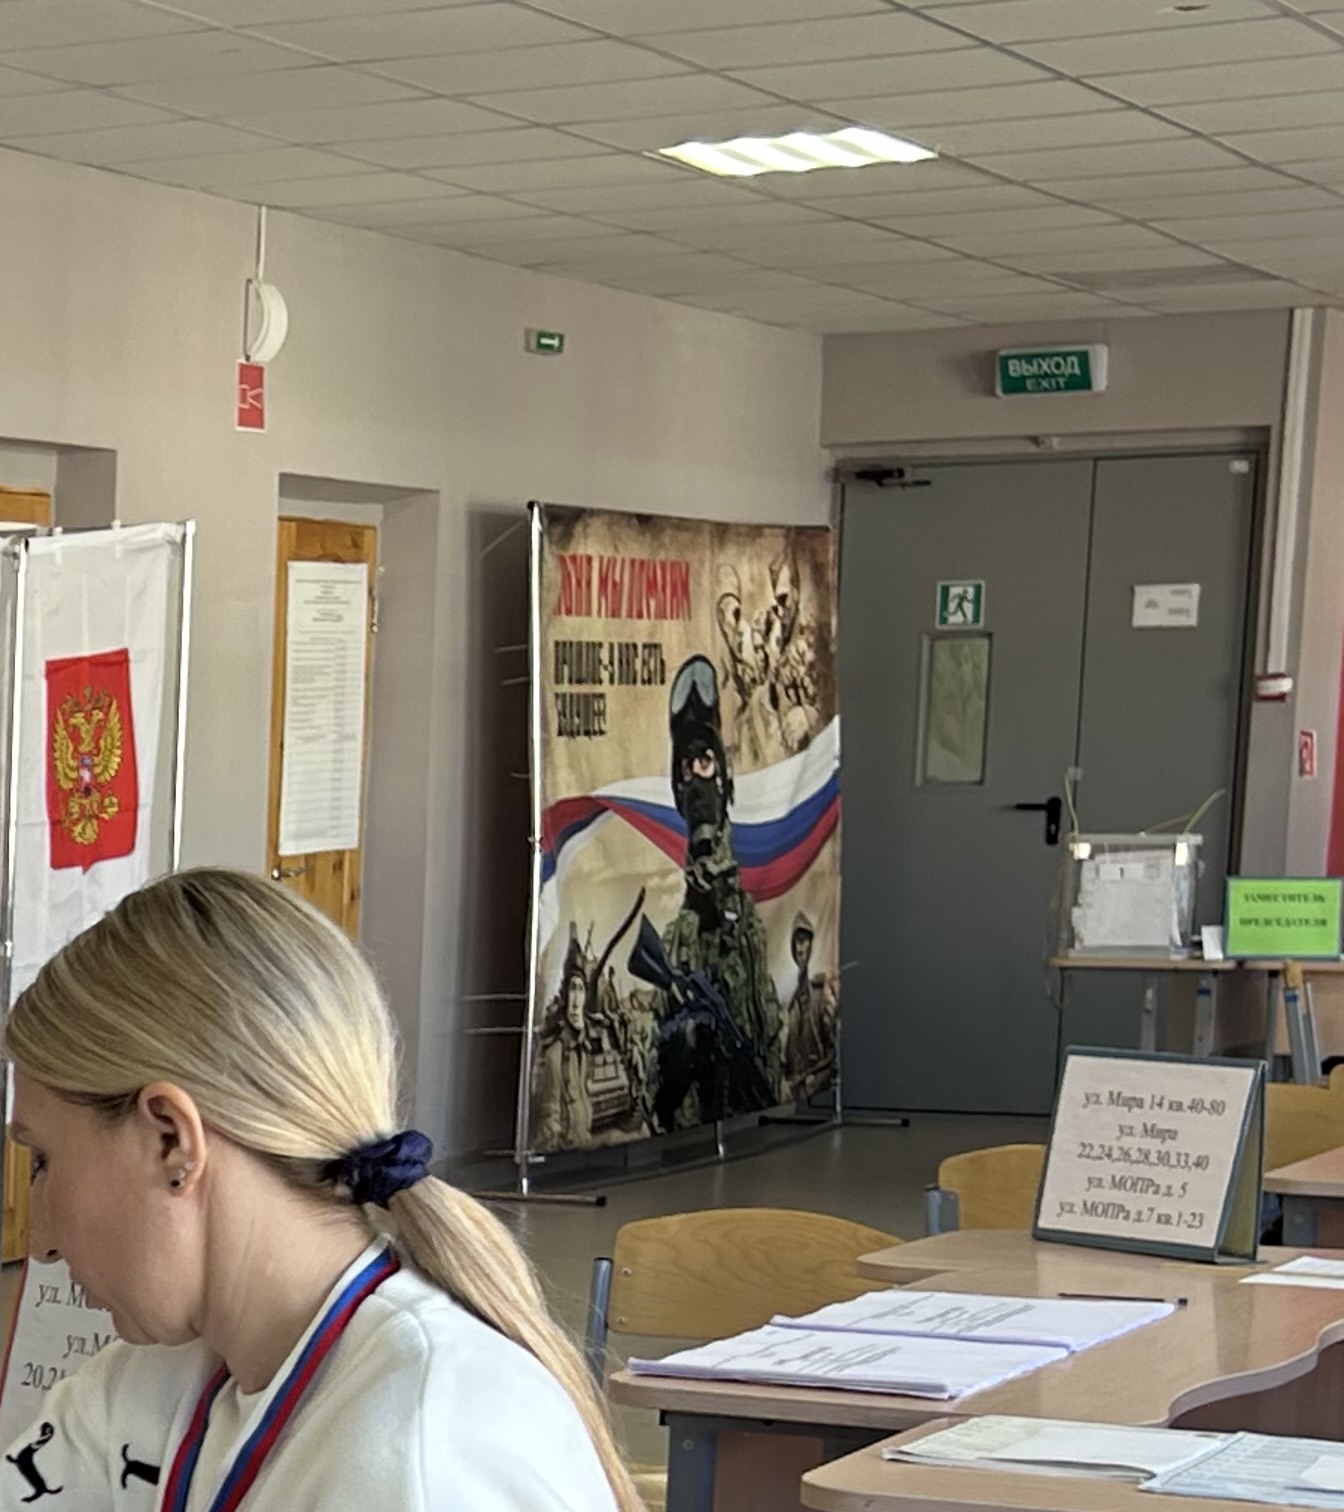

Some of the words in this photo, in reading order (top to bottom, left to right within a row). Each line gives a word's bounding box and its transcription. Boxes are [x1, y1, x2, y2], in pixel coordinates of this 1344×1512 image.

[1008, 356, 1080, 377] ВЫХОД
[1025, 377, 1068, 390] EXIT
[1106, 1091, 1145, 1112] Мира
[1149, 1094, 1164, 1110] 14
[1140, 1122, 1178, 1144] Мира
[1109, 1174, 1161, 1196] МОПРа
[1081, 1200, 1131, 1222] МОПРа
